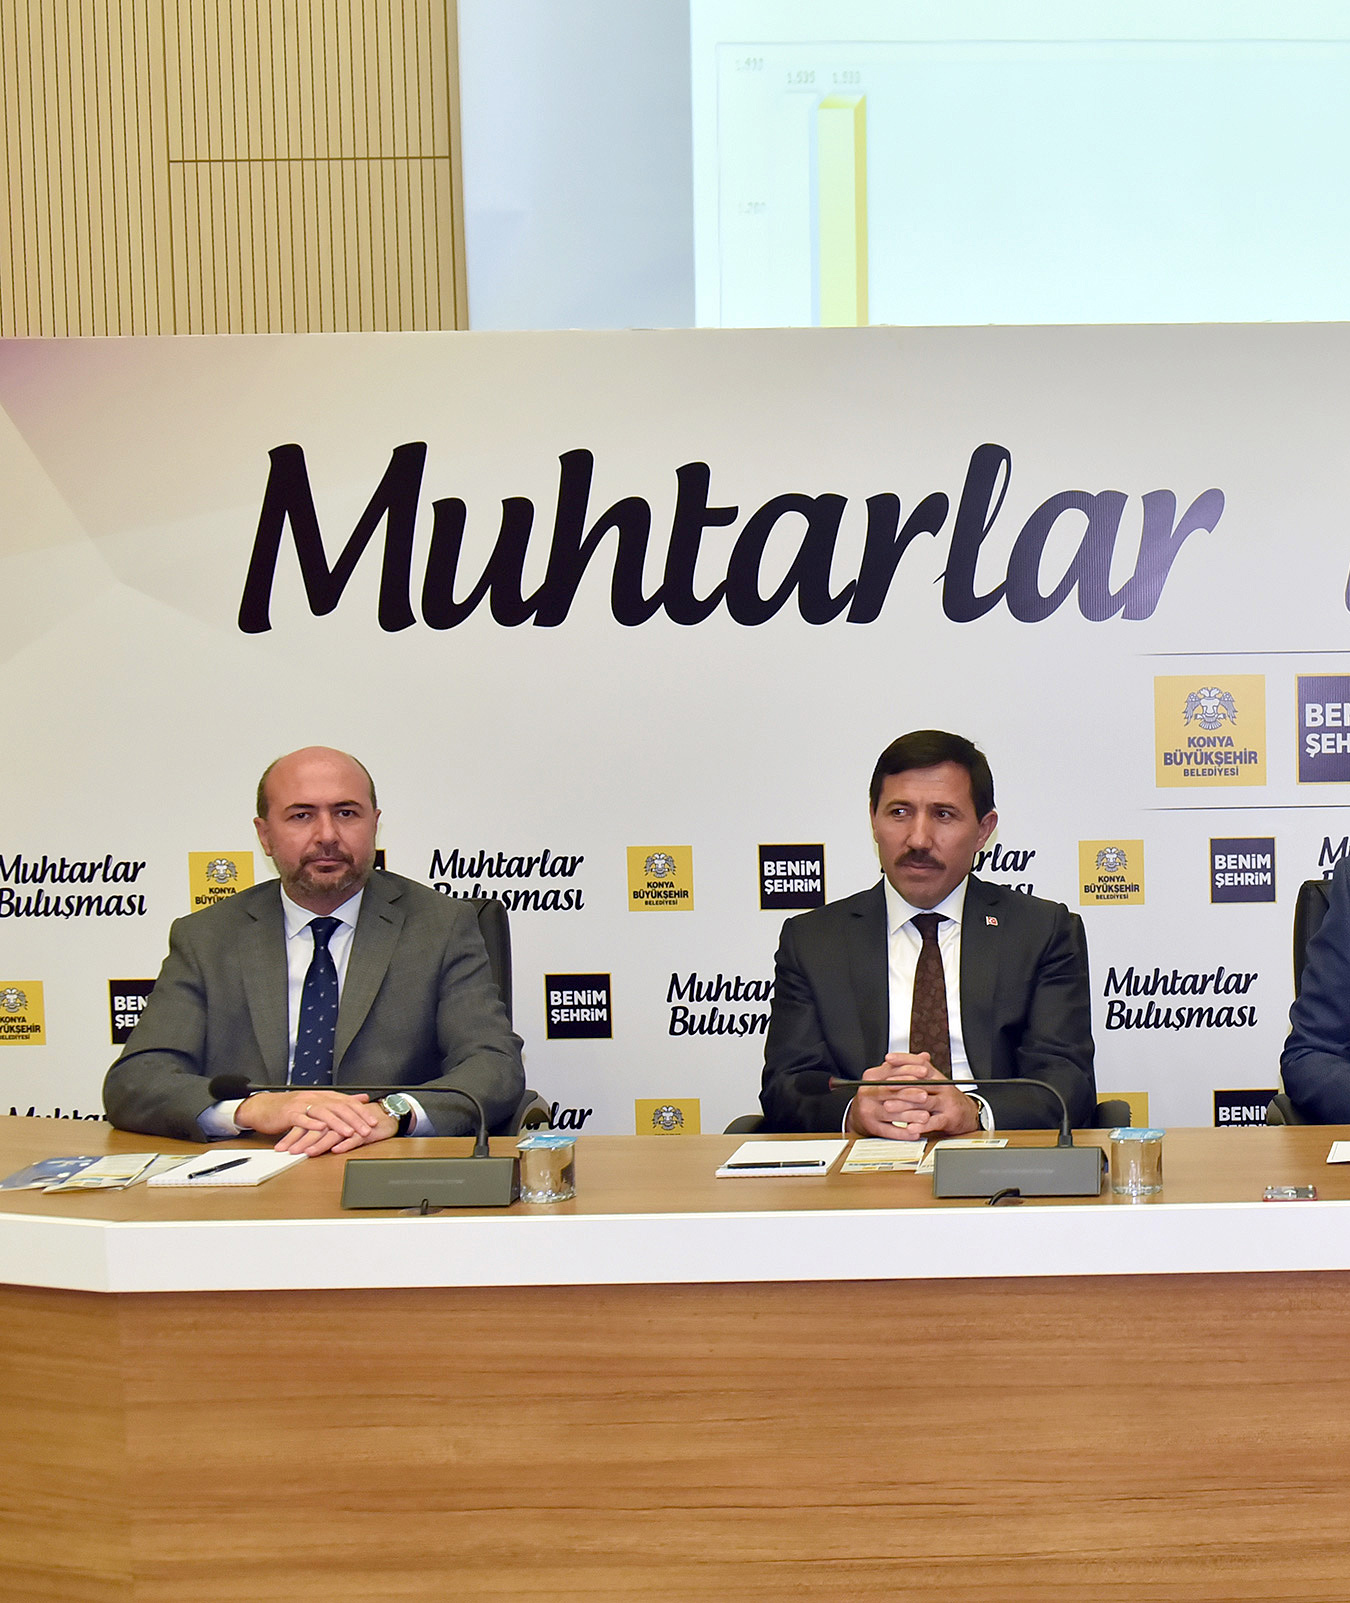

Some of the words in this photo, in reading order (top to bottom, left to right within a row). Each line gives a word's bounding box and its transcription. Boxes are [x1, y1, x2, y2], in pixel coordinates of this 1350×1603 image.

[238, 441, 1225, 633] Muhtarlar
[1188, 736, 1234, 748] KONYA
[1163, 748, 1258, 767] BÜYÜKŞEHİR
[1183, 767, 1239, 777] BELEDİYESİ
[0, 854, 146, 884] Muhtarlar
[429, 849, 584, 879] Muhtarlar
[1098, 875, 1125, 883] KONYA
[0, 887, 147, 919] Buluşması
[633, 888, 689, 900] BÜYÜKŞEHİR
[1084, 883, 1140, 894] BÜYÜKŞEHİR
[666, 973, 775, 1003] Muhtar
[1103, 966, 1258, 997] Muhtarlar
[114, 996, 149, 1011] BEN
[1105, 1000, 1258, 1031] Buluşması
[669, 1006, 771, 1037] Buluşm
